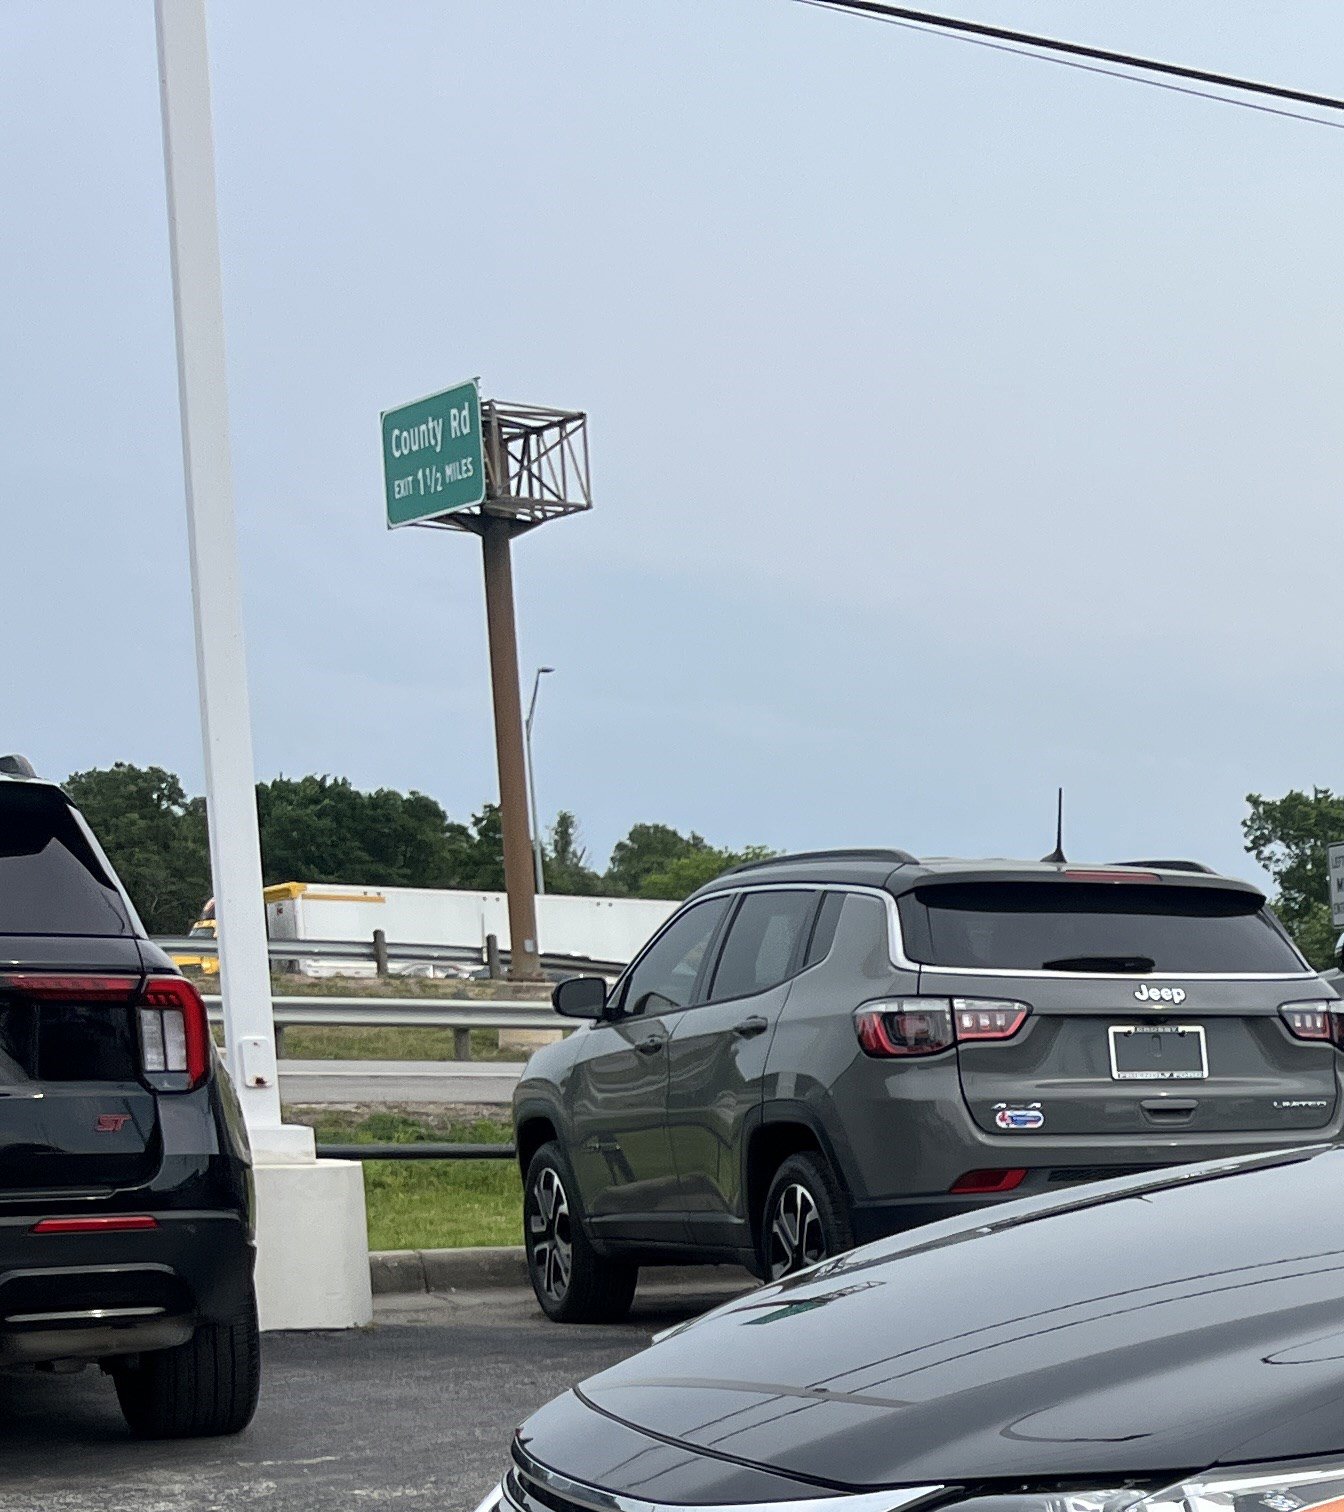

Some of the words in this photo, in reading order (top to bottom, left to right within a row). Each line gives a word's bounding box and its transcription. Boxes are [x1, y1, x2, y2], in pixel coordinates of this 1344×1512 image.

[391, 417, 443, 458] County
[450, 402, 470, 438] Rd
[394, 476, 413, 499] EXIT
[445, 457, 474, 483] MILES
[1331, 855, 1344, 869] LEFT
[1134, 984, 1186, 1004] Jeep
[95, 1113, 131, 1131] ST
